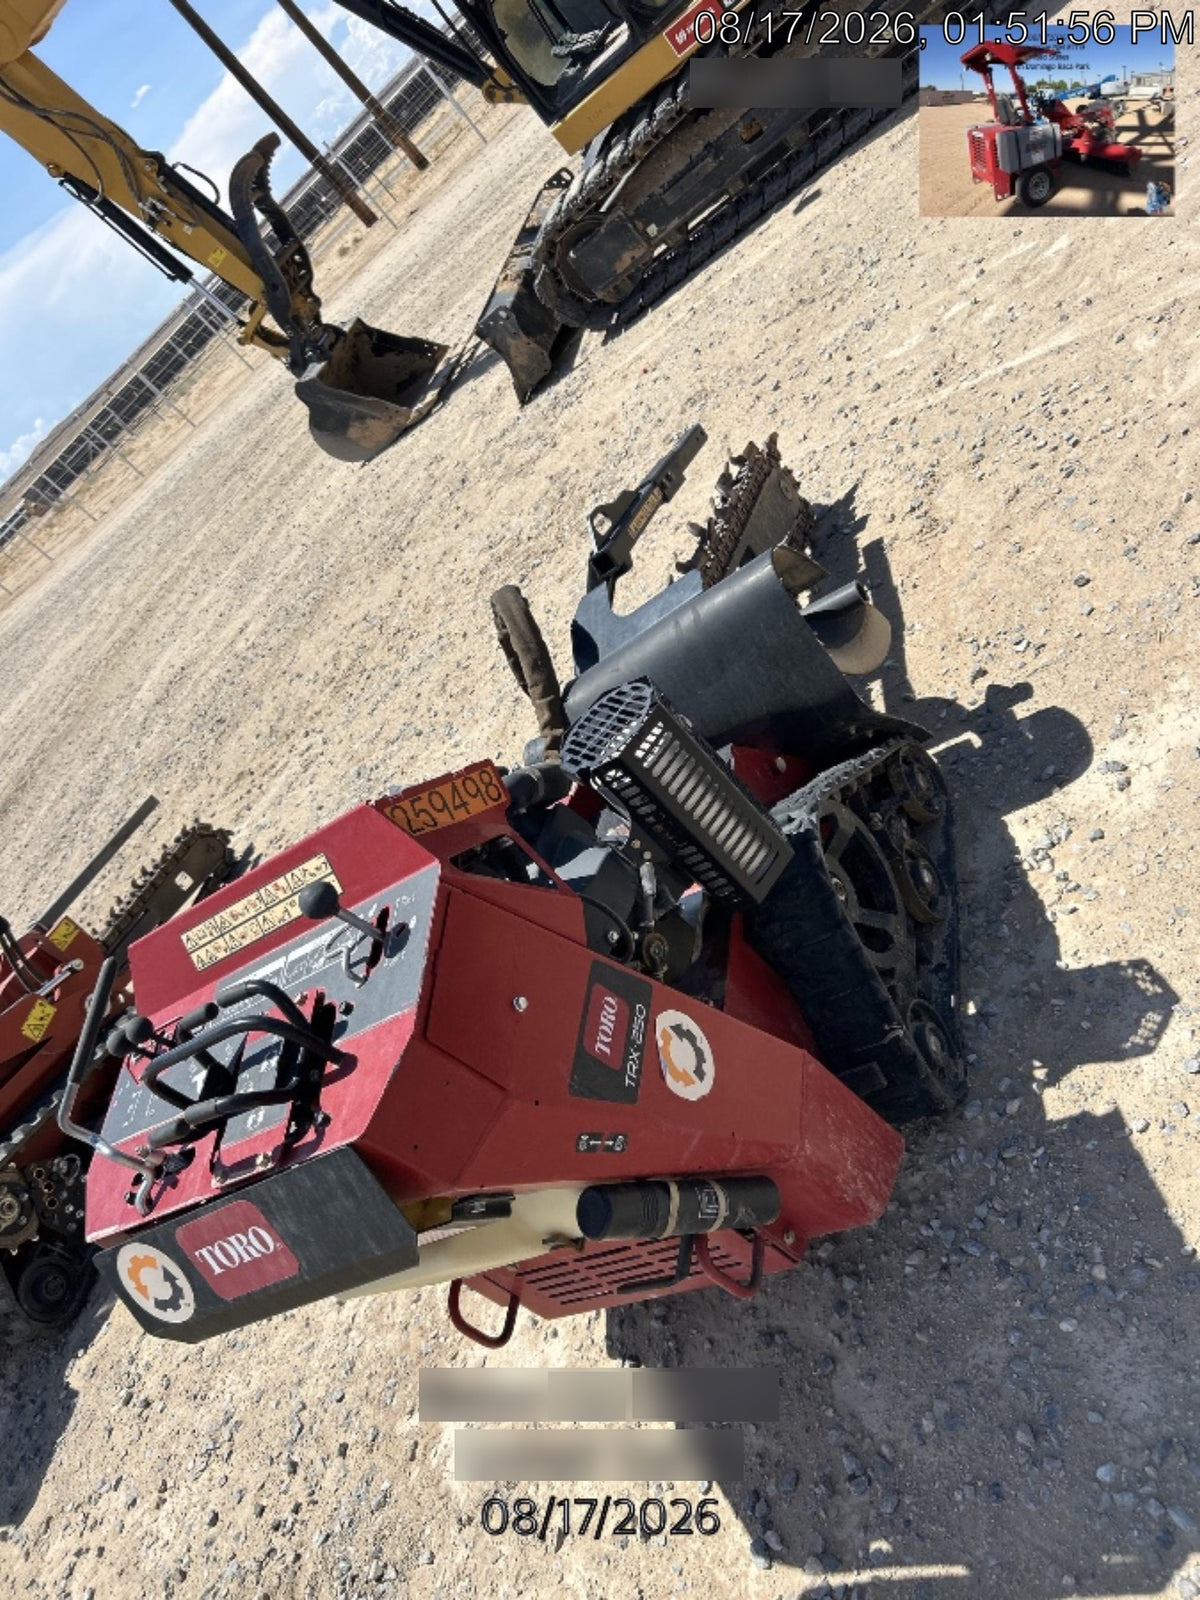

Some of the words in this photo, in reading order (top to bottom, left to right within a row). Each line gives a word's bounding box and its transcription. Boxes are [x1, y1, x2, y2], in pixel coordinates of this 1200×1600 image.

[390, 769, 502, 834] 259498
[595, 996, 618, 1056] TORO
[194, 1226, 275, 1276] TORO
